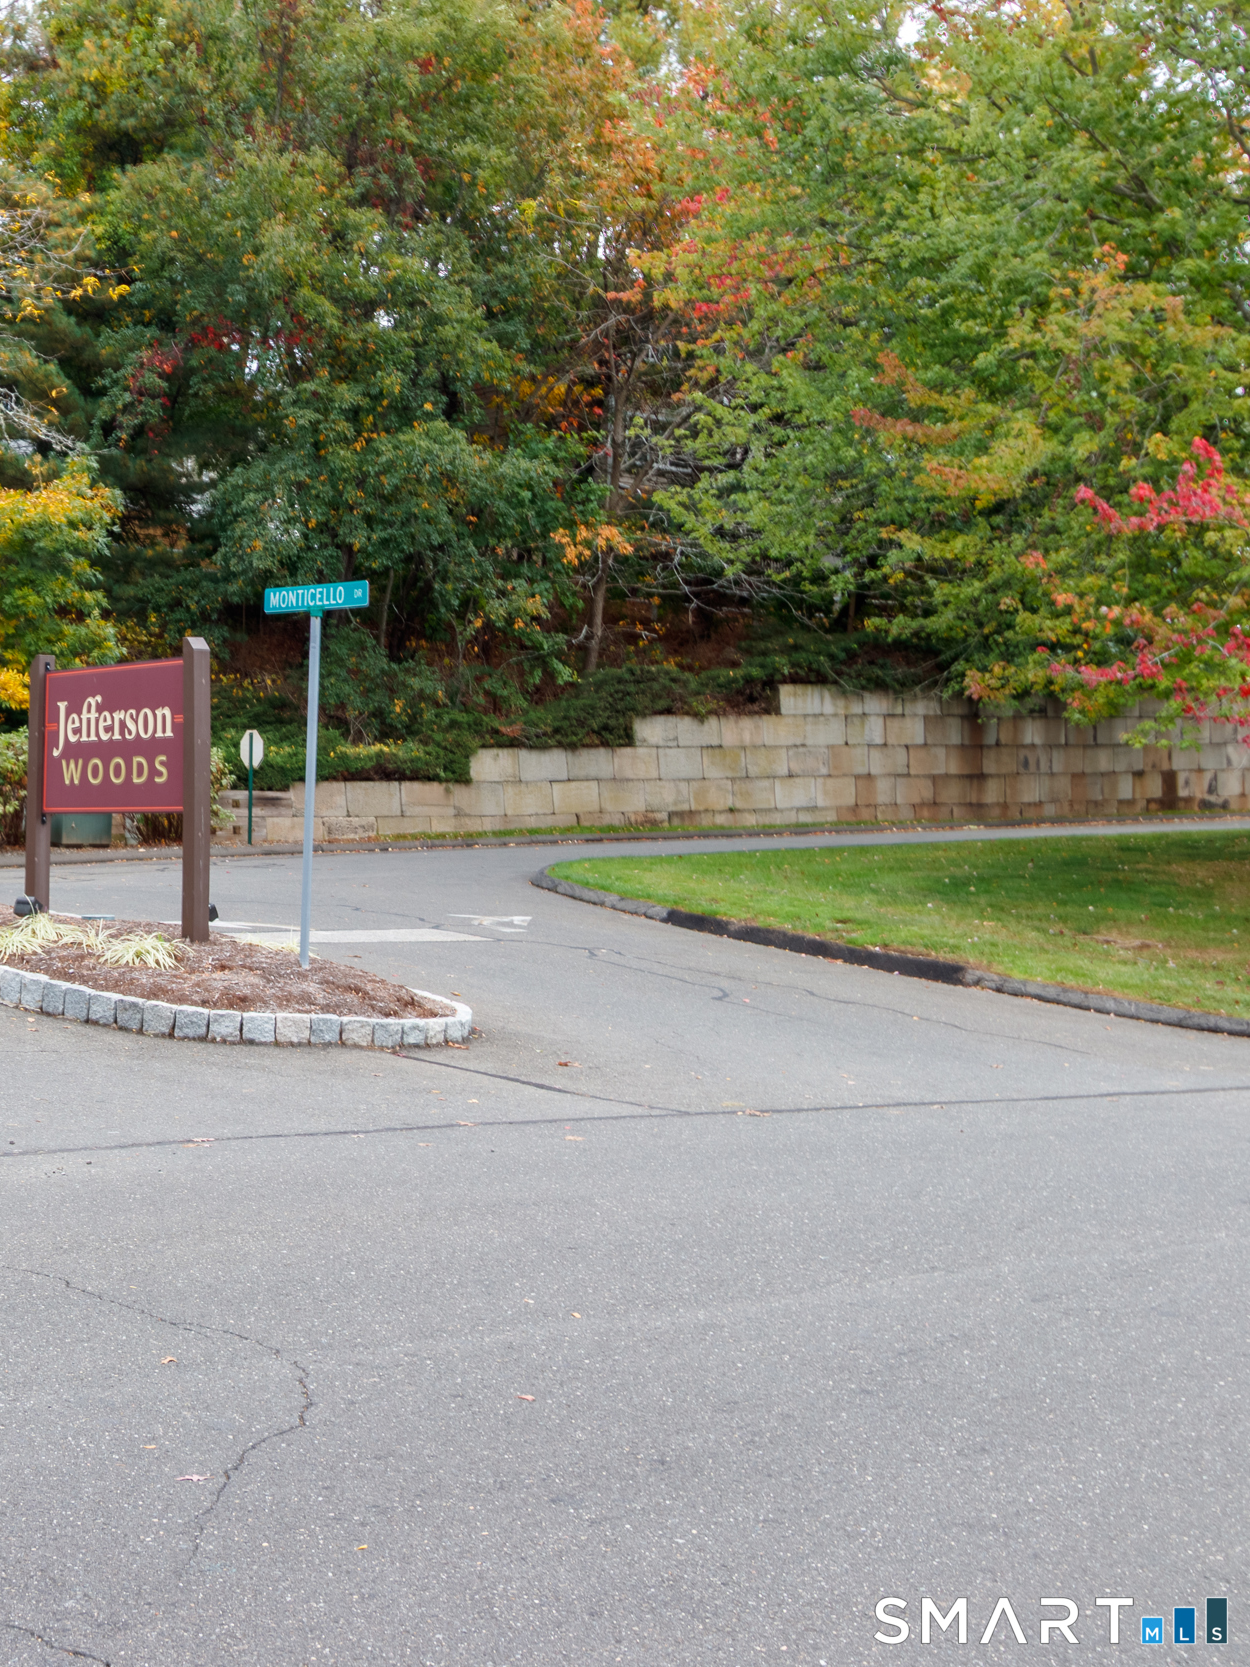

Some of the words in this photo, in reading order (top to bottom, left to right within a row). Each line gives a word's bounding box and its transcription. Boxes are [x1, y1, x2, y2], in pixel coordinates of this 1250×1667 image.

[270, 586, 345, 608] MONTICELLO
[353, 588, 363, 599] DR
[52, 694, 174, 757] Jefferson
[61, 754, 168, 786] WOODS
